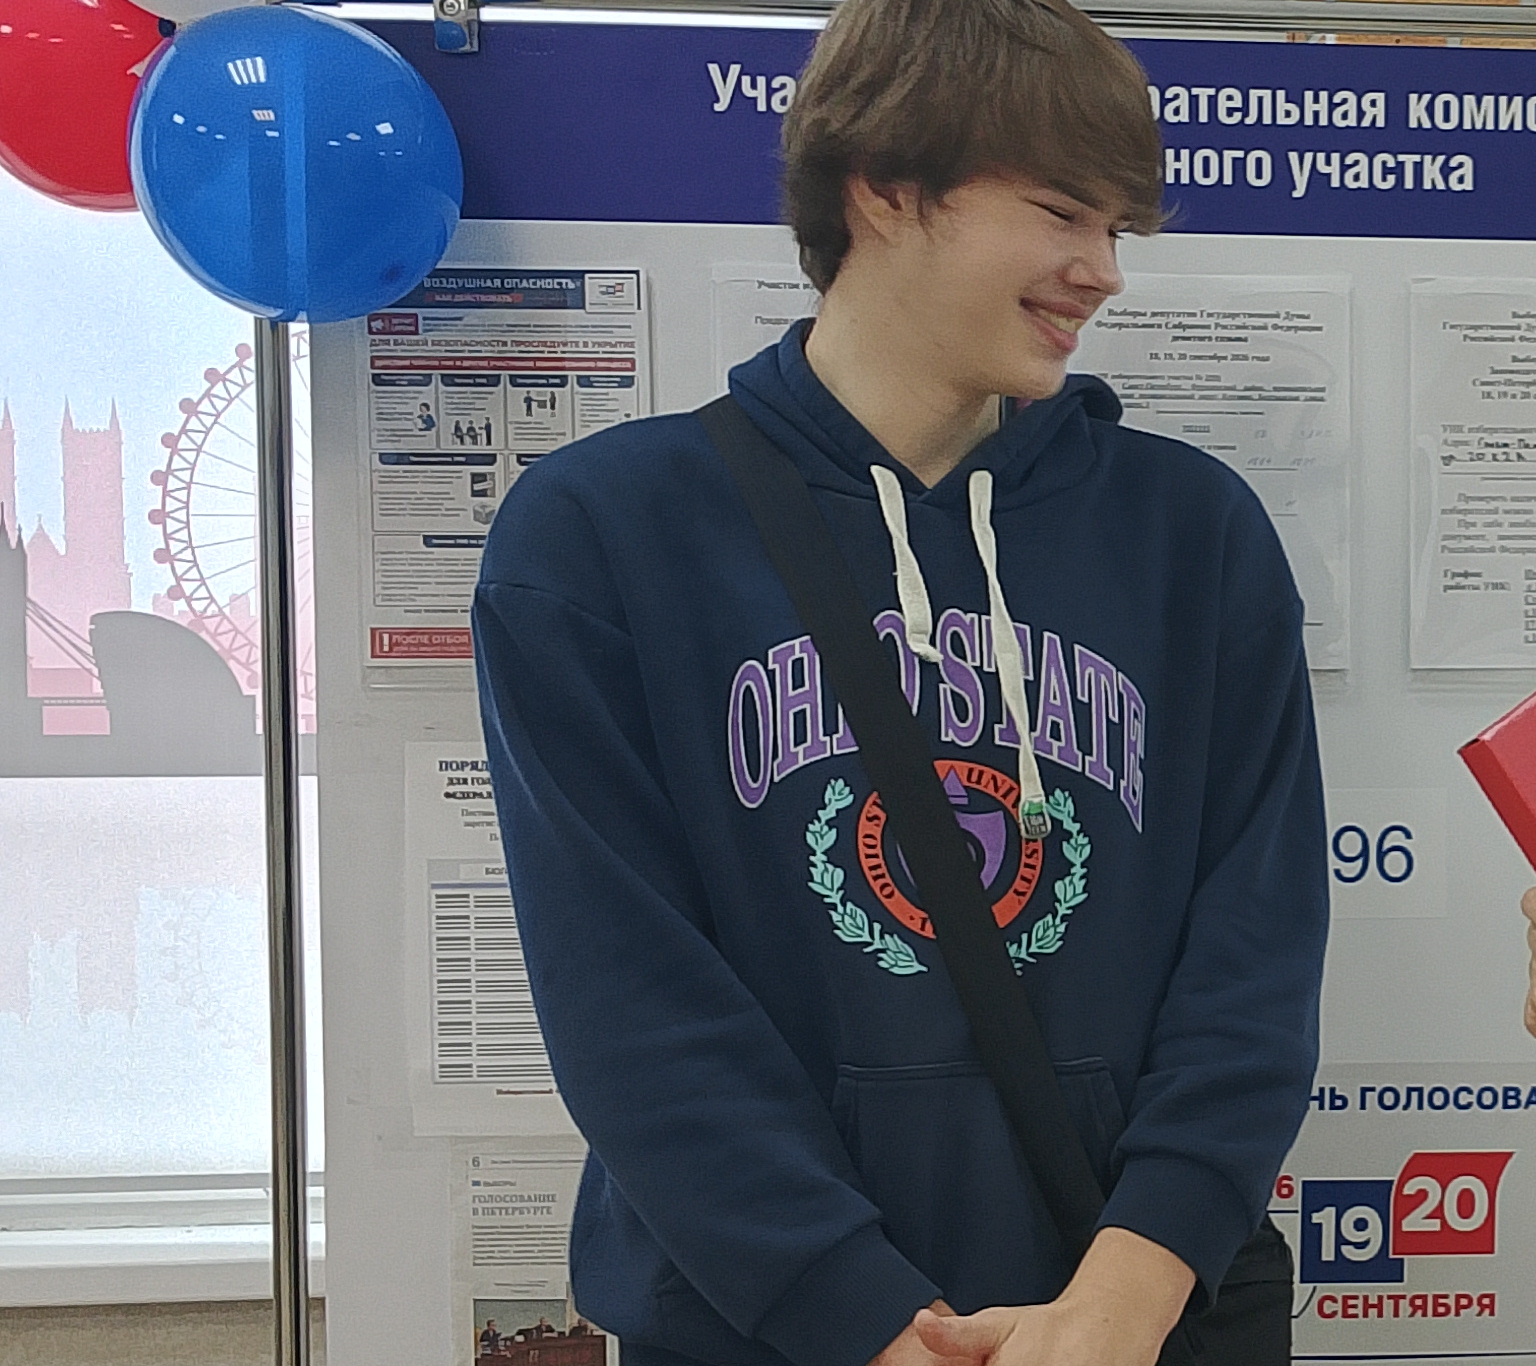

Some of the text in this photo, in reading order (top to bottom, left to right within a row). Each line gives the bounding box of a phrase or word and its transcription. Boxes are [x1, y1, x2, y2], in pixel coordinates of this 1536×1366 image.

[707, 64, 797, 113] Уча
[1164, 148, 1475, 198] ного участка
[438, 760, 490, 772] ПОРЯД
[1331, 824, 1415, 883] 96
[1309, 1087, 1349, 1111] НЬ
[471, 1156, 481, 1168] 6
[1310, 1175, 1490, 1262] 19 20
[1316, 1293, 1497, 1319] СЕНТЯБРЯ
